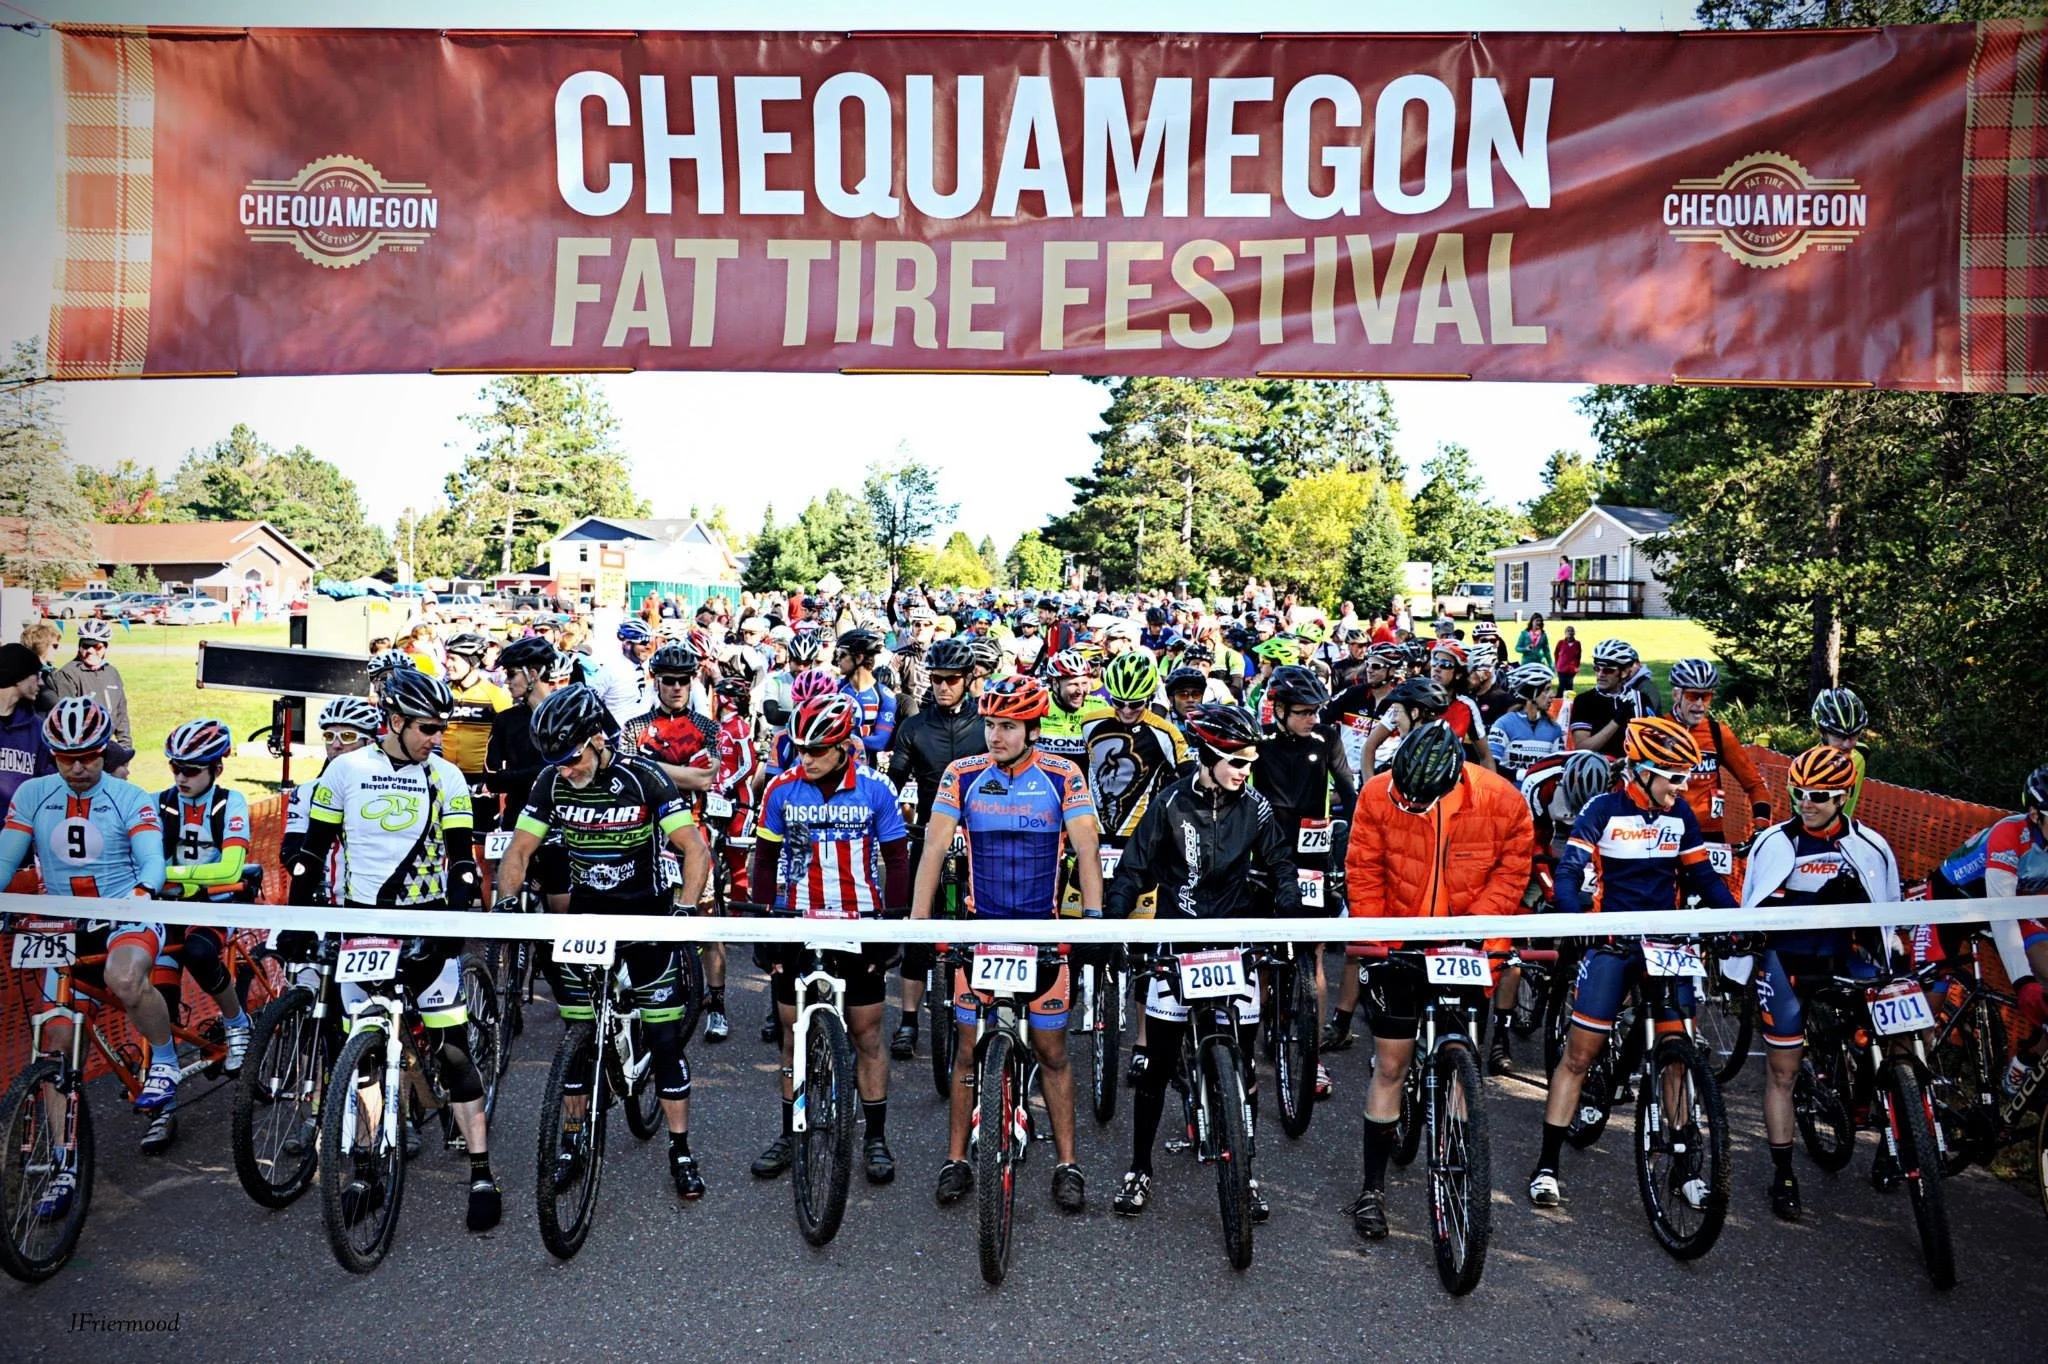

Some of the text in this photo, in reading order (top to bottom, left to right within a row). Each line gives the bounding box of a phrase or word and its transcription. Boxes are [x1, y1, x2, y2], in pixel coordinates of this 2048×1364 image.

[554, 70, 1555, 219] CHEQUAMEGON
[320, 179, 360, 192] FAT TIRE
[1744, 175, 1786, 190] FAT TIRE
[239, 194, 438, 228] CHEQUAMEGON
[1663, 193, 1867, 227] CHEQUAMEGON
[316, 230, 360, 245] FESTIVAL
[1742, 230, 1788, 244] FESTIVAL
[550, 232, 1548, 351] FAT TIRE FESTIVAL
[361, 782, 427, 793] Bicycle Company
[556, 805, 641, 824] SHO-AIR
[68, 825, 86, 859] 9
[184, 830, 199, 860] 9
[1708, 851, 1727, 868] 92
[1800, 863, 1838, 874] OWER
[21, 936, 67, 958] 2795
[345, 950, 391, 974] 2797
[981, 958, 1028, 981] 2776
[1435, 957, 1482, 977] 2786
[1190, 964, 1236, 989] 2801
[1876, 996, 1925, 1026] 3701
